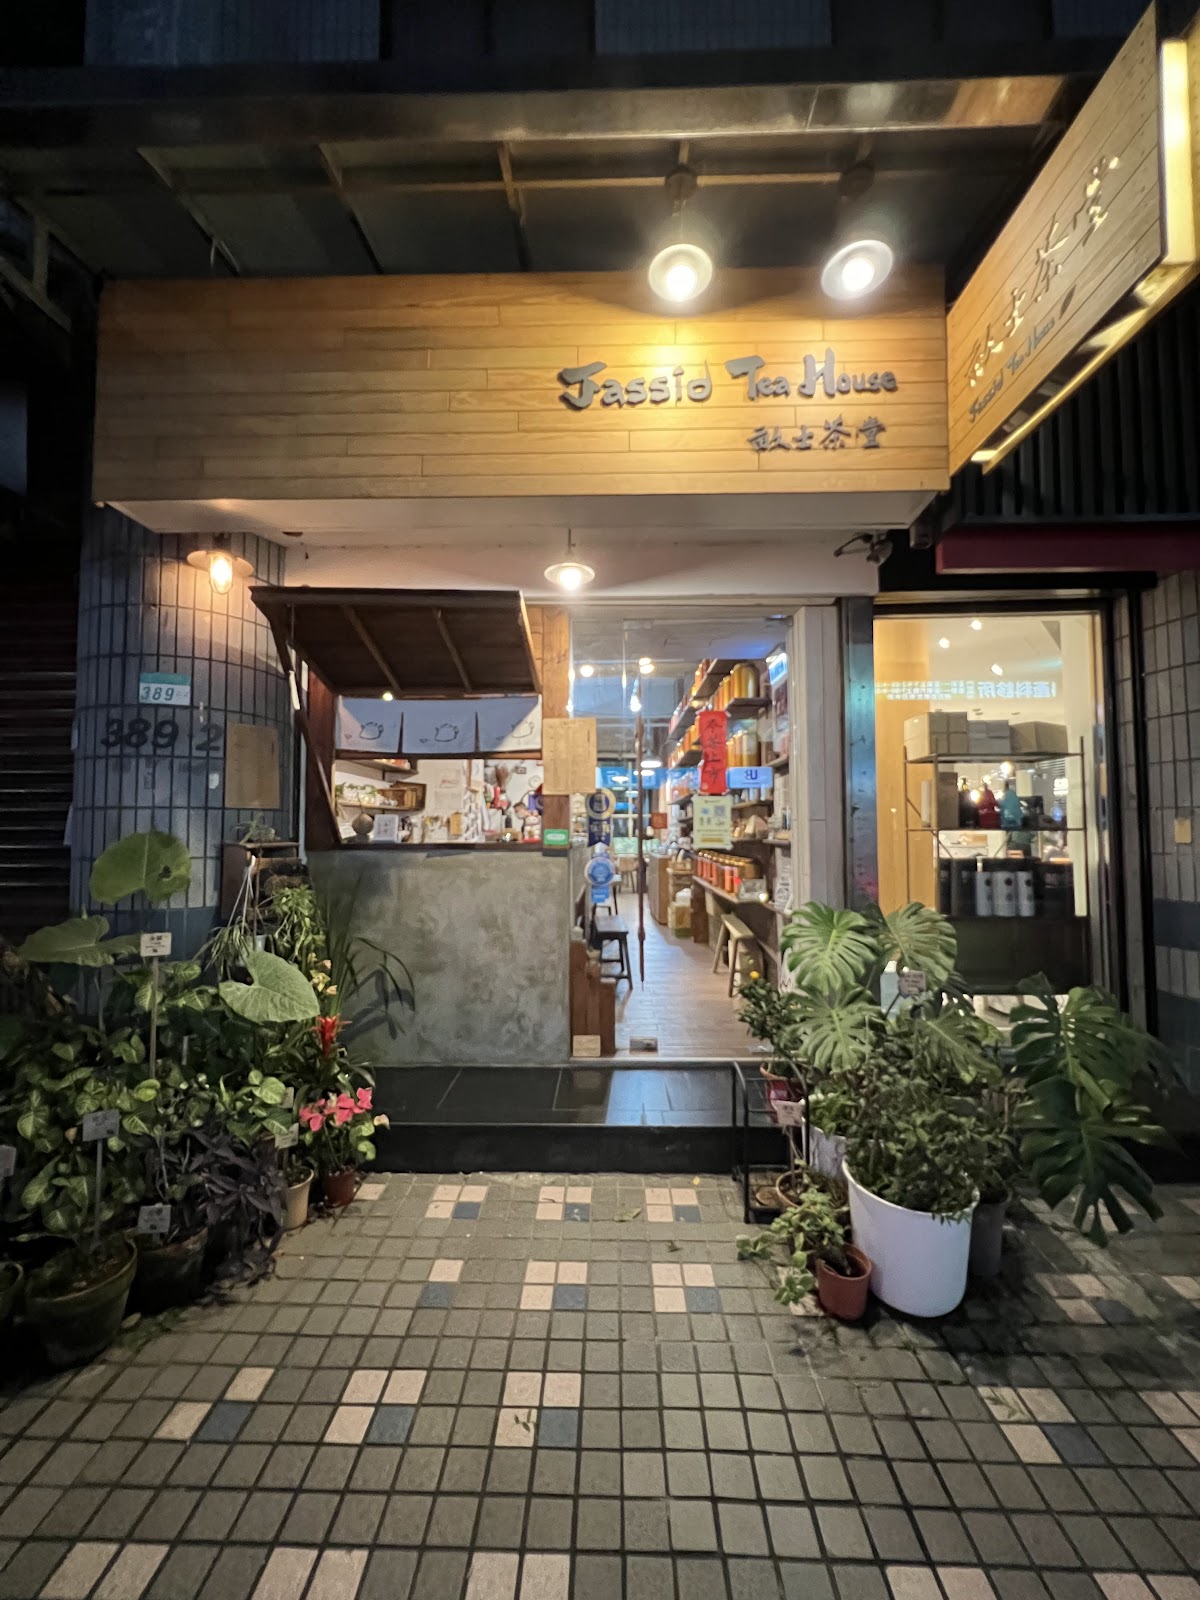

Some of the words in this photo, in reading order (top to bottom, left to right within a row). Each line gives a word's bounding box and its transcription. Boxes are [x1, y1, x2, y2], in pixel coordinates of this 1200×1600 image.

[557, 360, 713, 410] Jassid
[724, 354, 791, 400] Tea
[800, 347, 899, 398] House
[141, 686, 175, 701] 389
[100, 717, 180, 749] 389
[195, 722, 224, 752] 2
